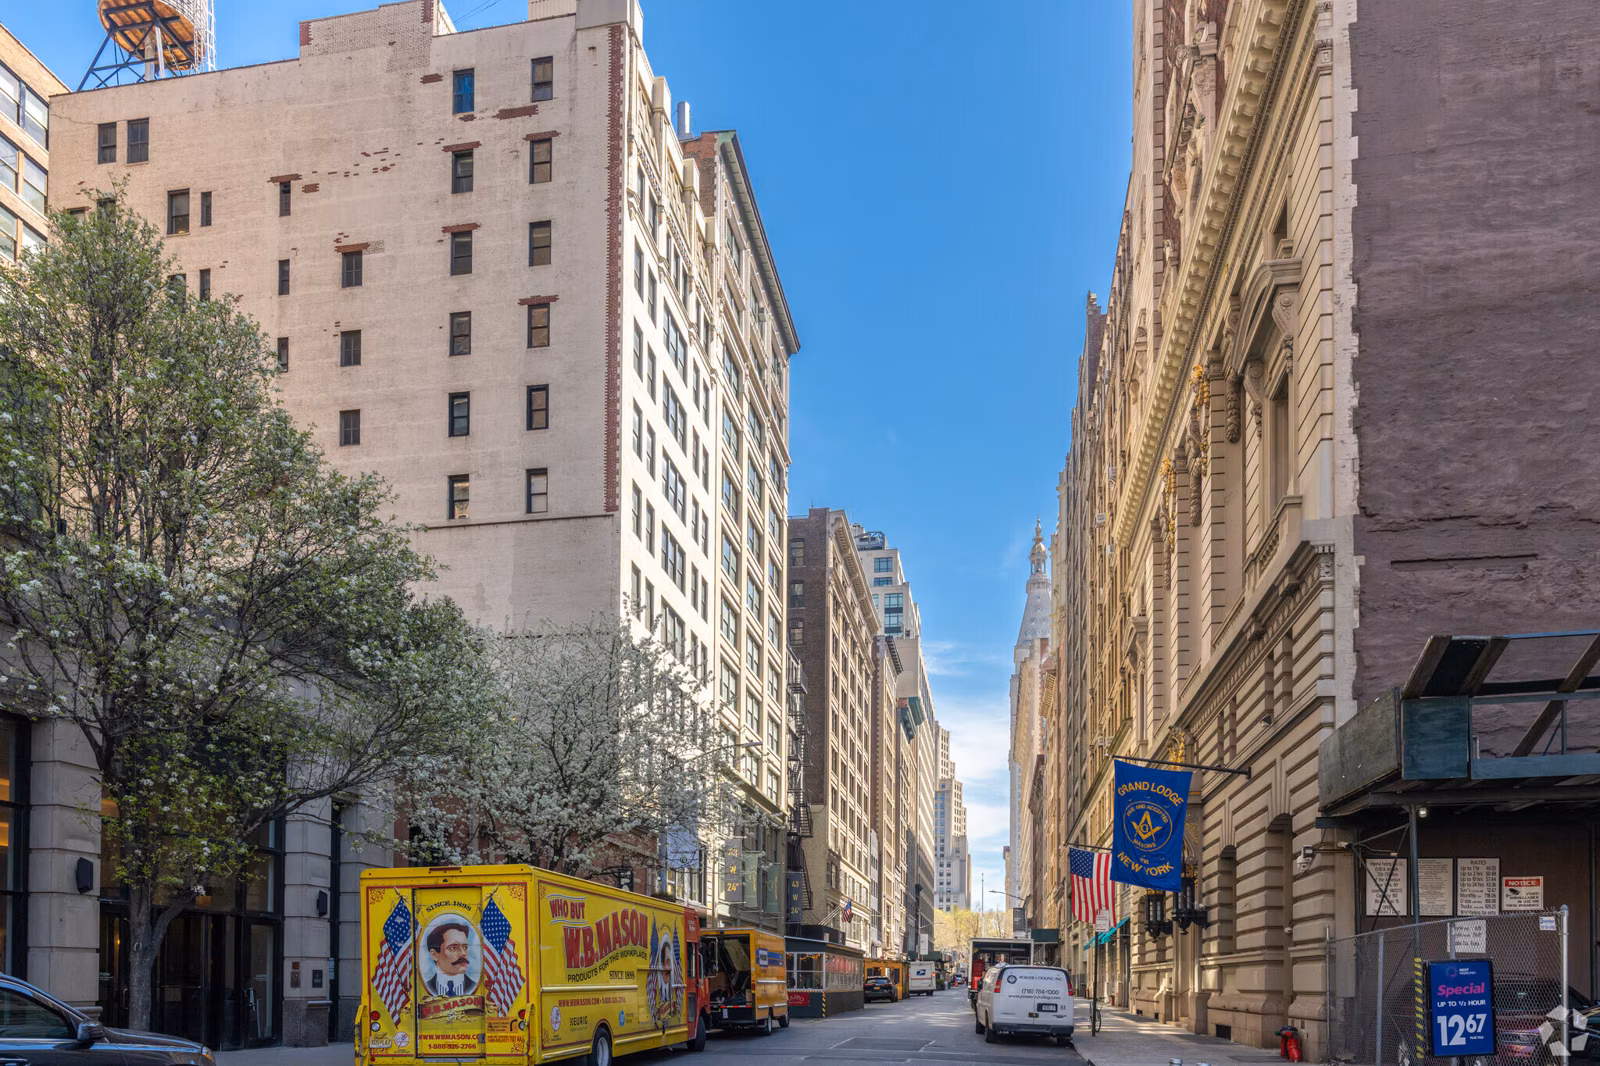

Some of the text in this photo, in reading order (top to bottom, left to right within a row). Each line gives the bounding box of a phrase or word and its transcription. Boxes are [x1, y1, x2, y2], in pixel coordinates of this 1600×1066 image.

[1118, 782, 1184, 806] GRAND LODGE
[1117, 852, 1174, 876] NEW YORK
[426, 901, 450, 912] SINCE
[549, 899, 585, 919] WHO BUT
[567, 950, 647, 982] PRODUCTS FOR THE WORKPLACE
[610, 970, 624, 980] SINCE
[1438, 982, 1484, 998] Special
